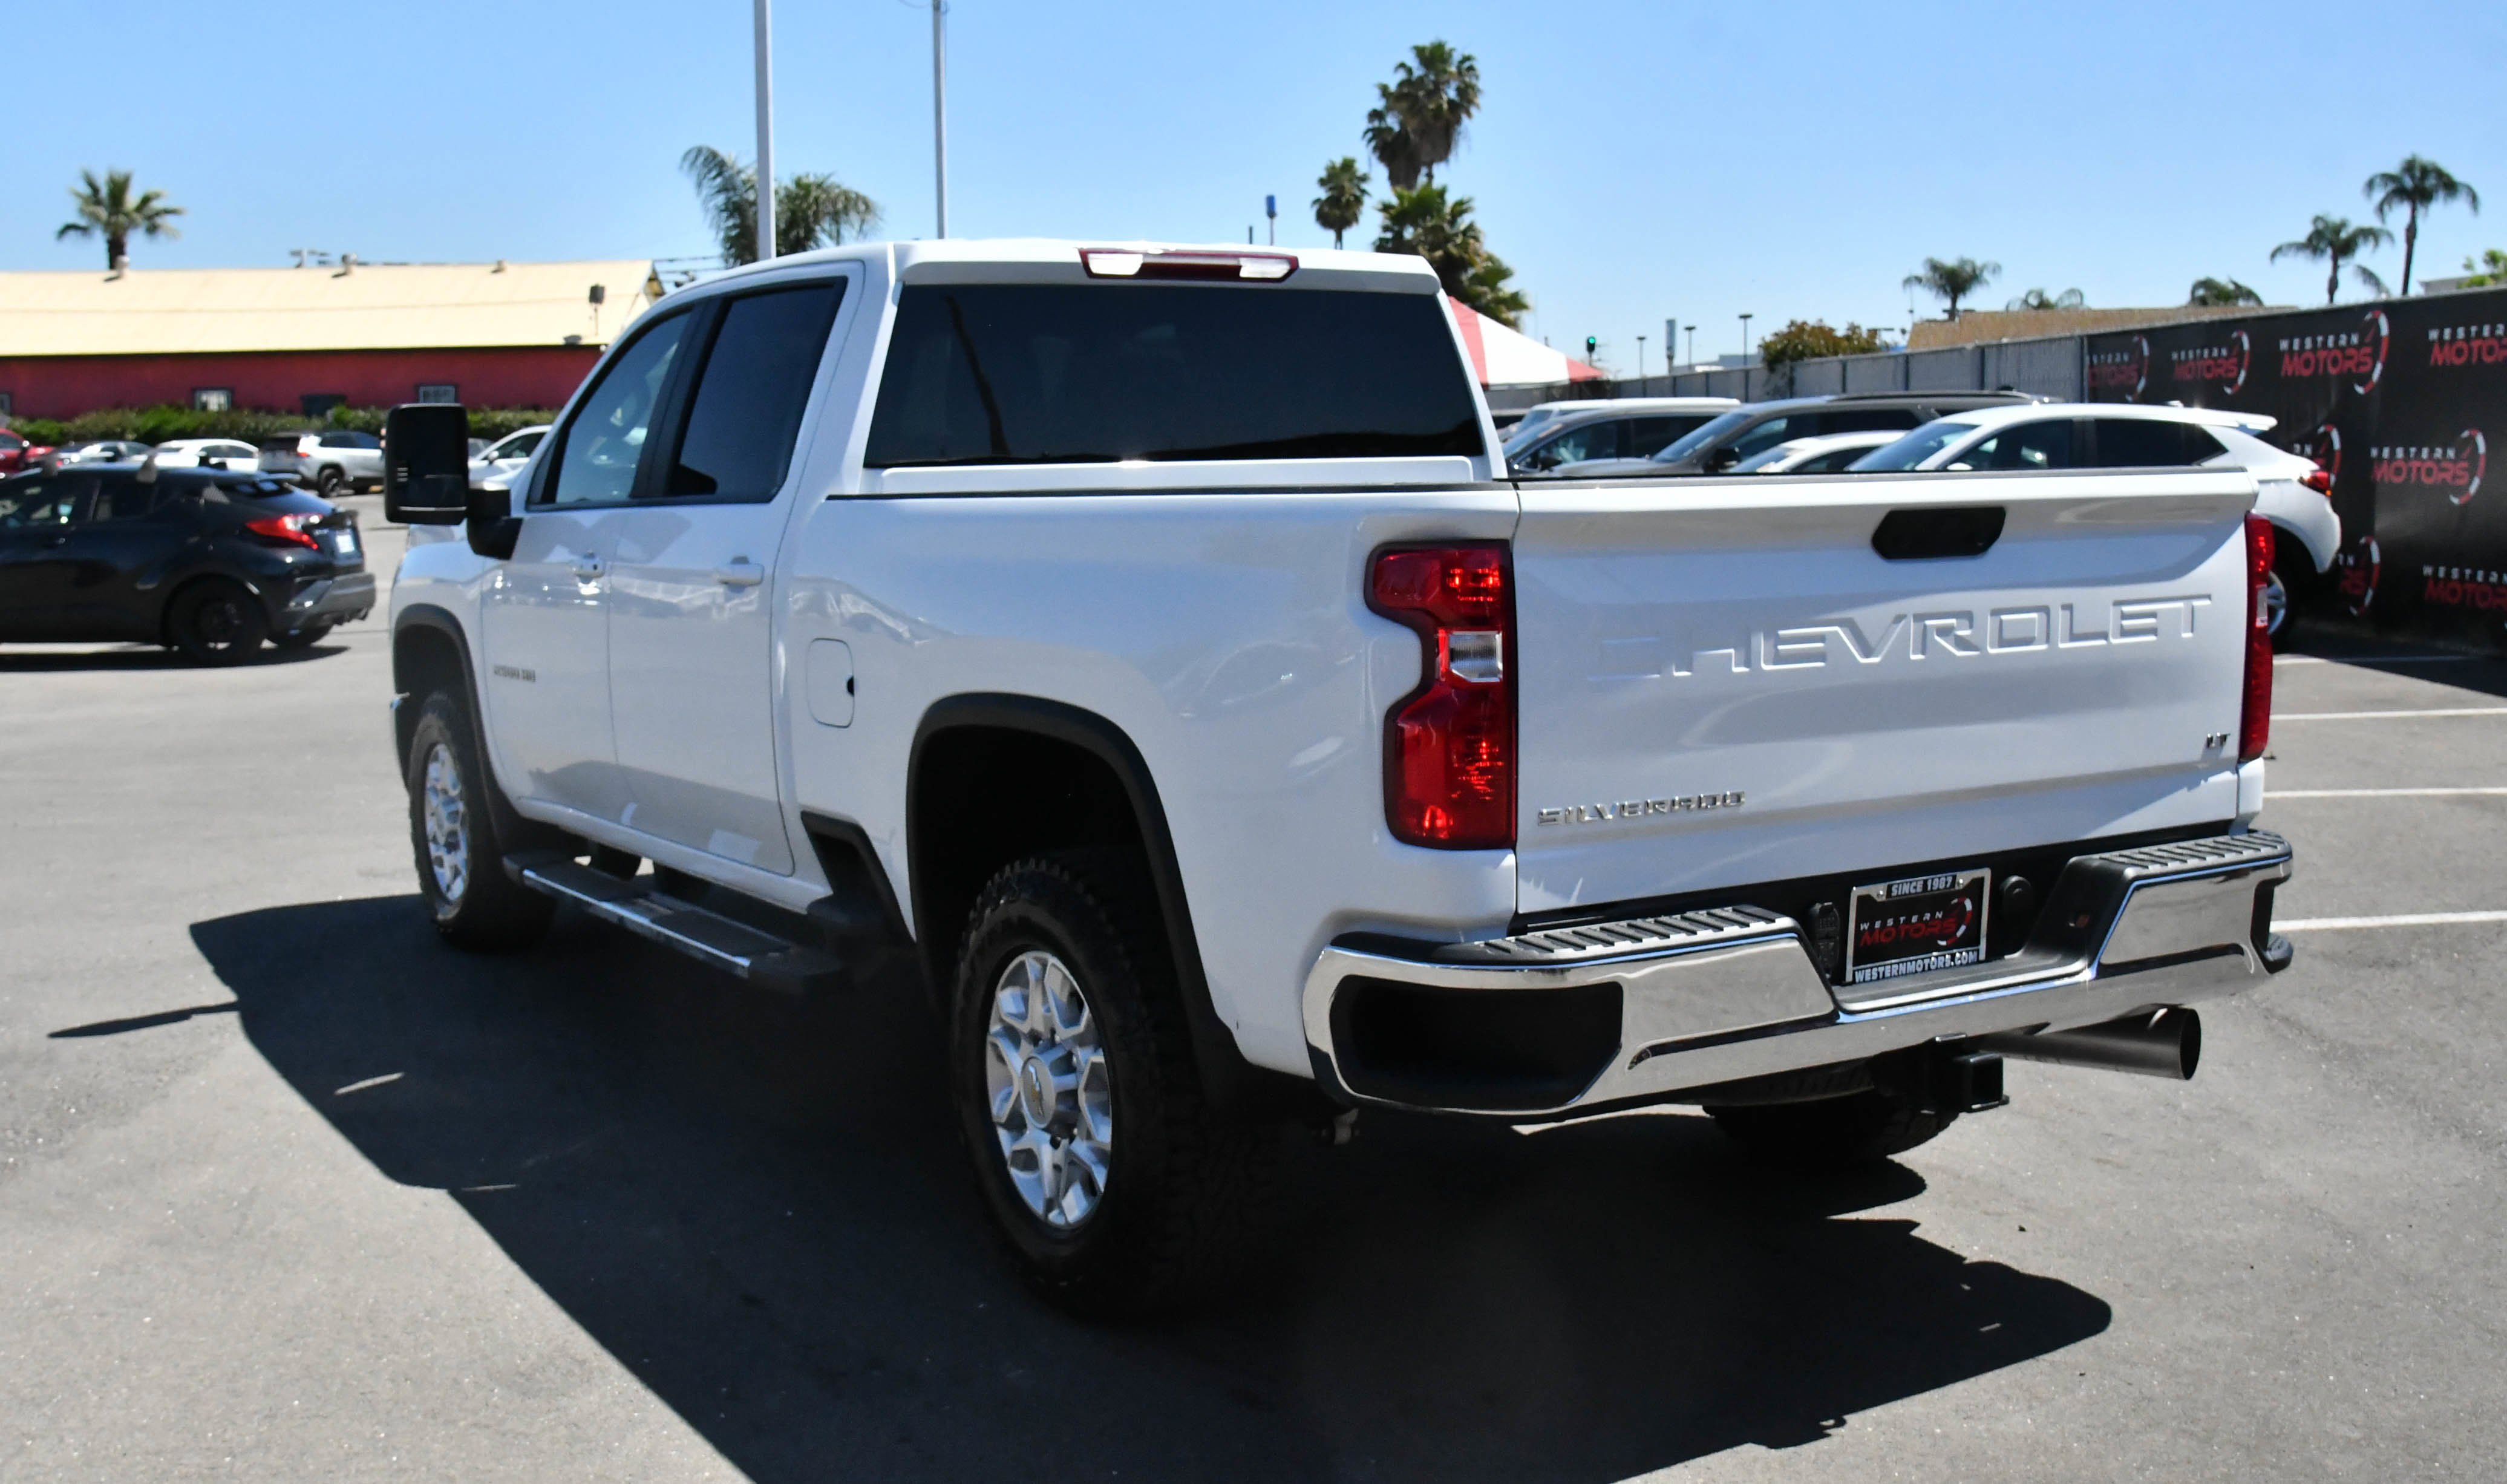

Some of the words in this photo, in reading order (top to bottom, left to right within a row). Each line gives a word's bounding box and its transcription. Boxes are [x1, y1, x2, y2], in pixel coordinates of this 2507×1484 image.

[2280, 333, 2359, 351] WESTERN
[2280, 347, 2374, 378] MOTORS
[2370, 440, 2456, 459] WESTERN
[2371, 459, 2469, 485] MOTORS
[2205, 731, 2231, 749] LT
[1537, 791, 1745, 826] SILVERADO
[1891, 880, 1923, 897] SINCE
[1927, 876, 1953, 891] 1987
[1860, 910, 1943, 931] WESTERN
[1860, 917, 1957, 947] MOTORS
[1854, 951, 1978, 984] WESTERNMOTORS.COM
